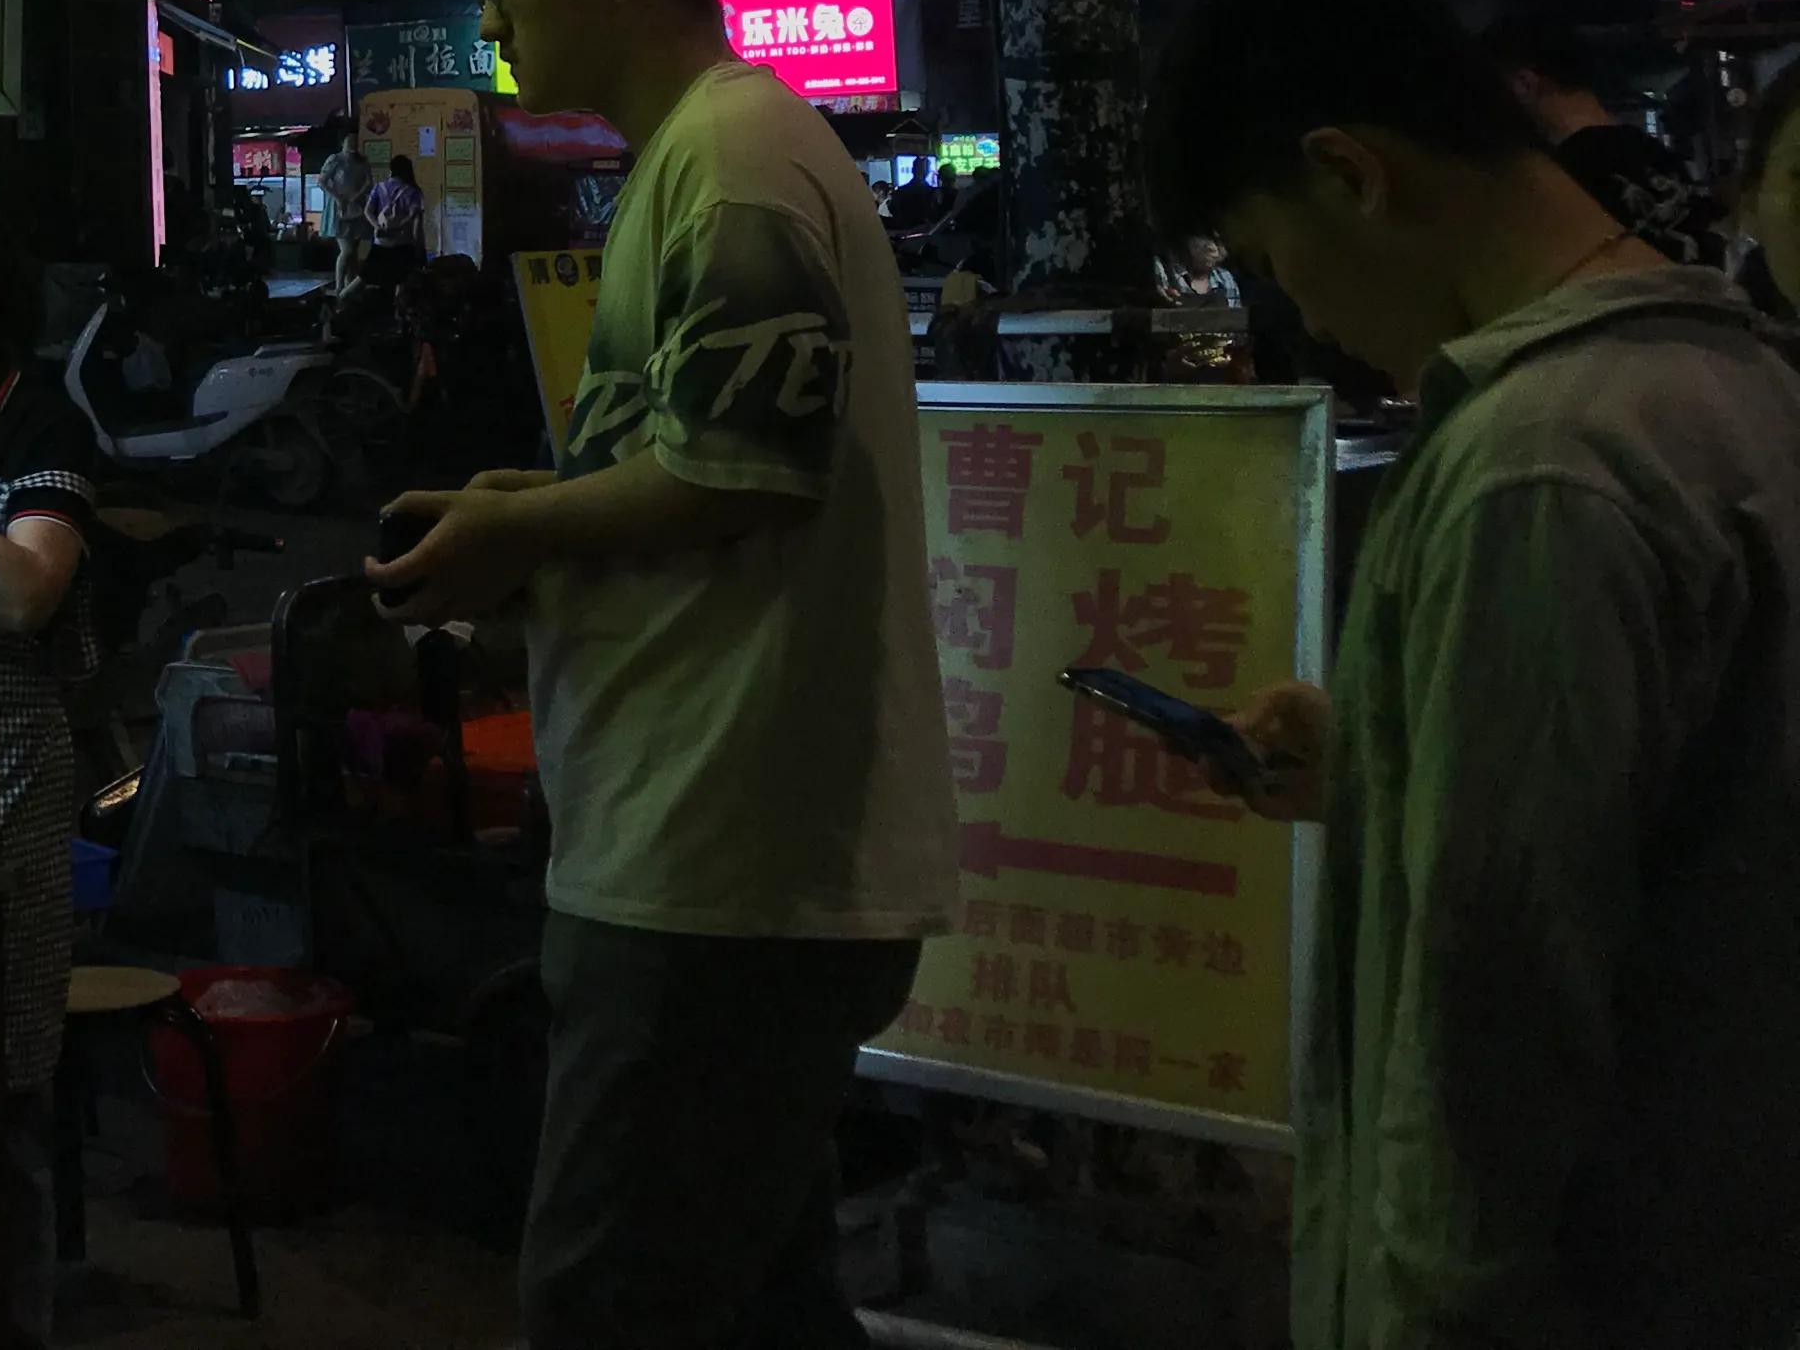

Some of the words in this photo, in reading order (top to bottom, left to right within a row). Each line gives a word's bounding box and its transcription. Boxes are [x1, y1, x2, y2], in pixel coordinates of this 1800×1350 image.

[353, 39, 496, 89] 兰州拉面
[743, 49, 766, 59] LOVE
[939, 422, 1171, 546] 曹记
